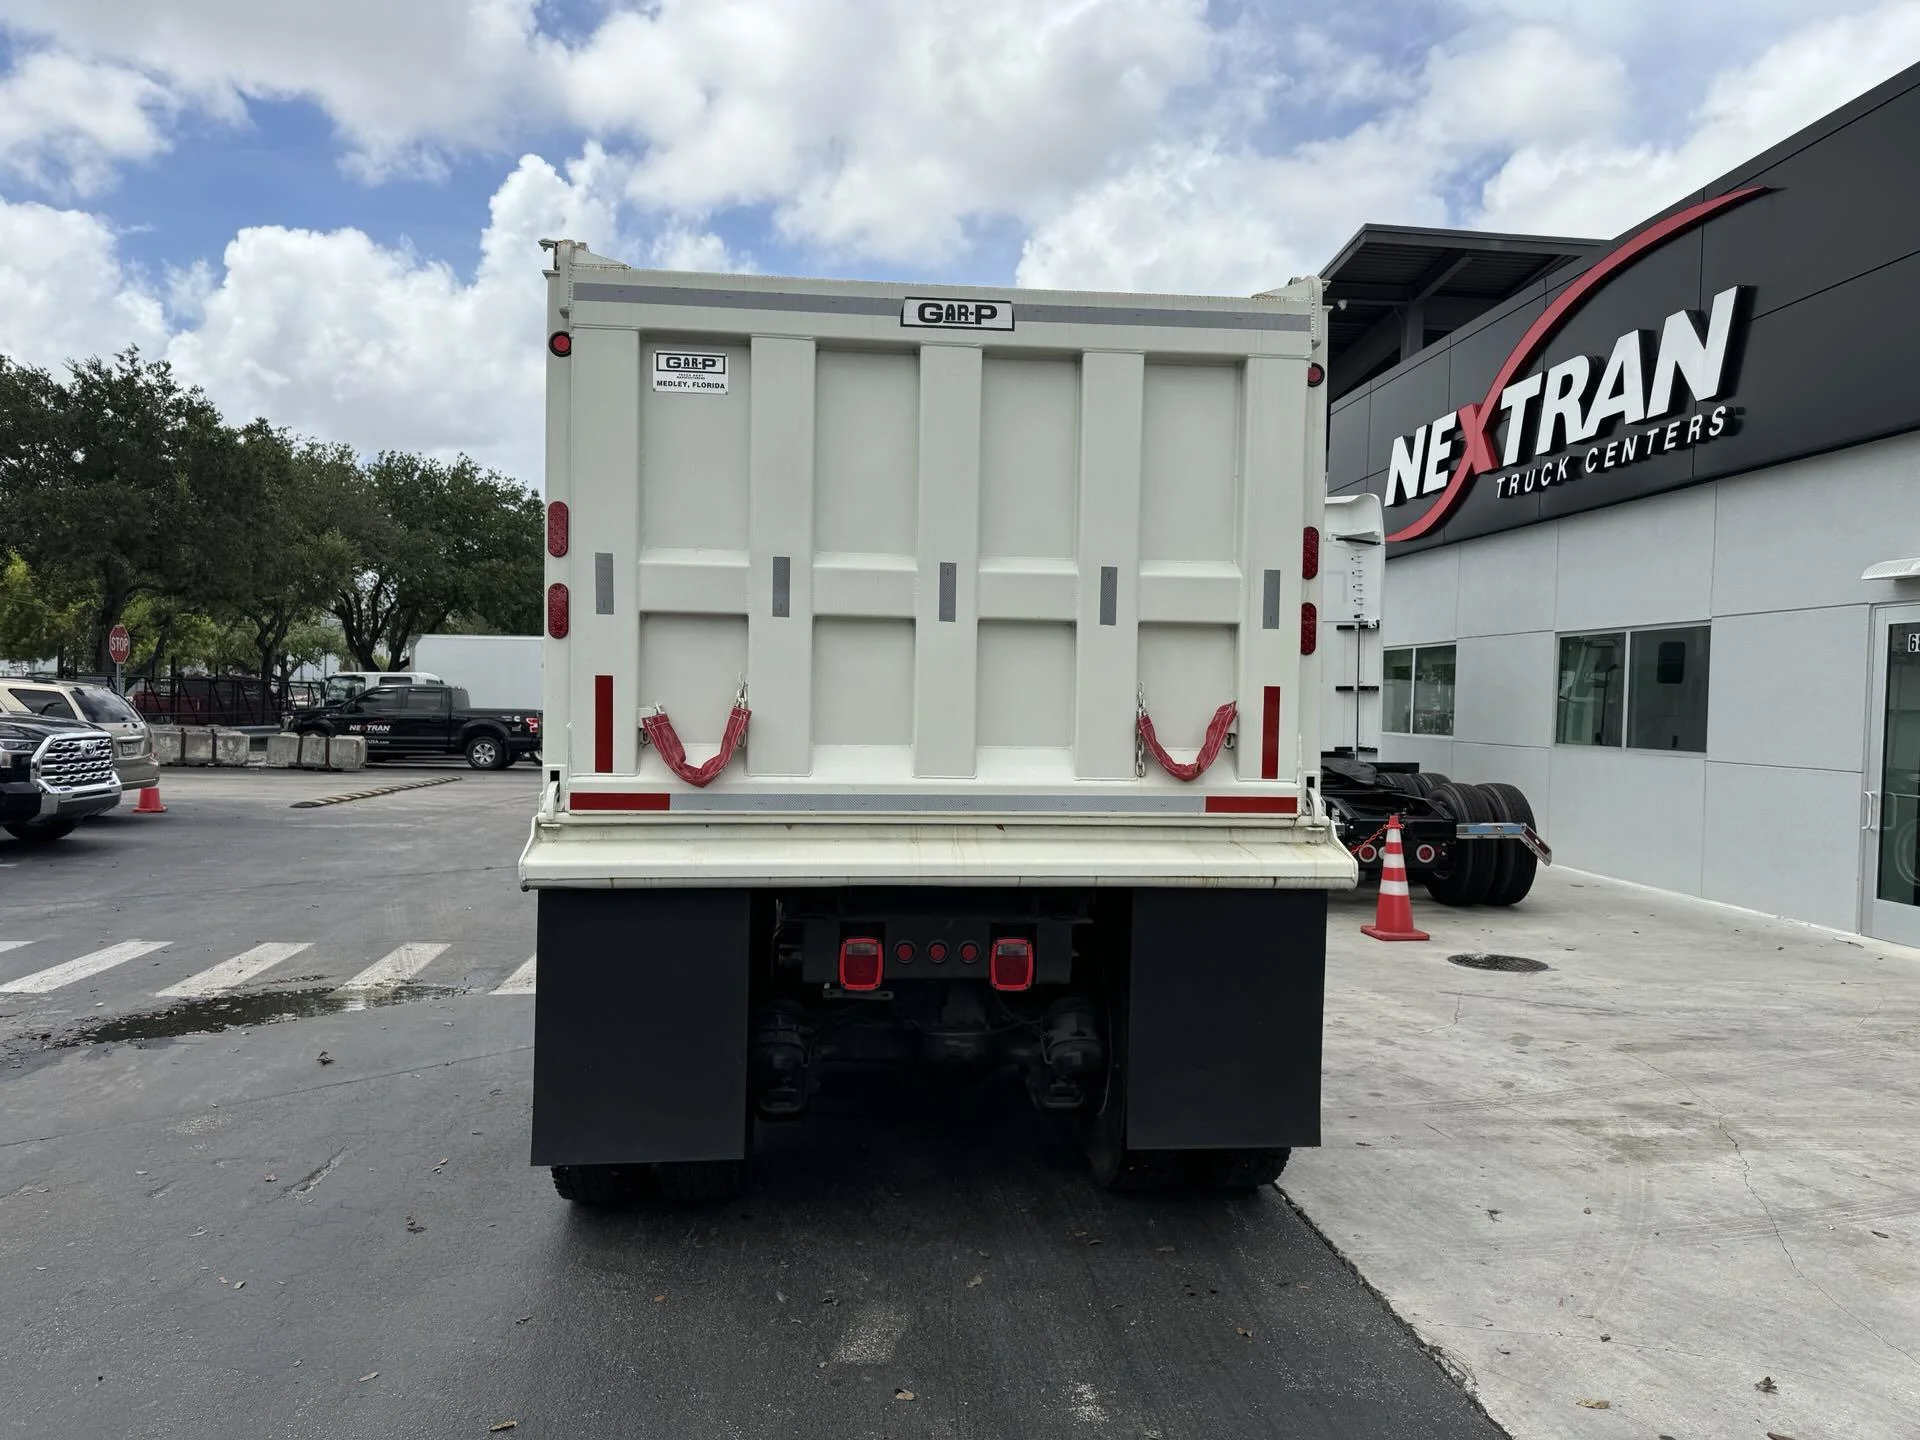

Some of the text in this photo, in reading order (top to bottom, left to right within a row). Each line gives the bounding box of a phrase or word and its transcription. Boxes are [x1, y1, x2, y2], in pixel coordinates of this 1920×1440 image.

[917, 302, 998, 325] GAR-P
[666, 356, 717, 370] GAR-P
[656, 380, 726, 389] MEDLEY, FLORIDA
[1384, 285, 1738, 508] NEXTRAN
[1496, 405, 1727, 499] TRUCK CENTERS
[111, 636, 129, 651] STOP
